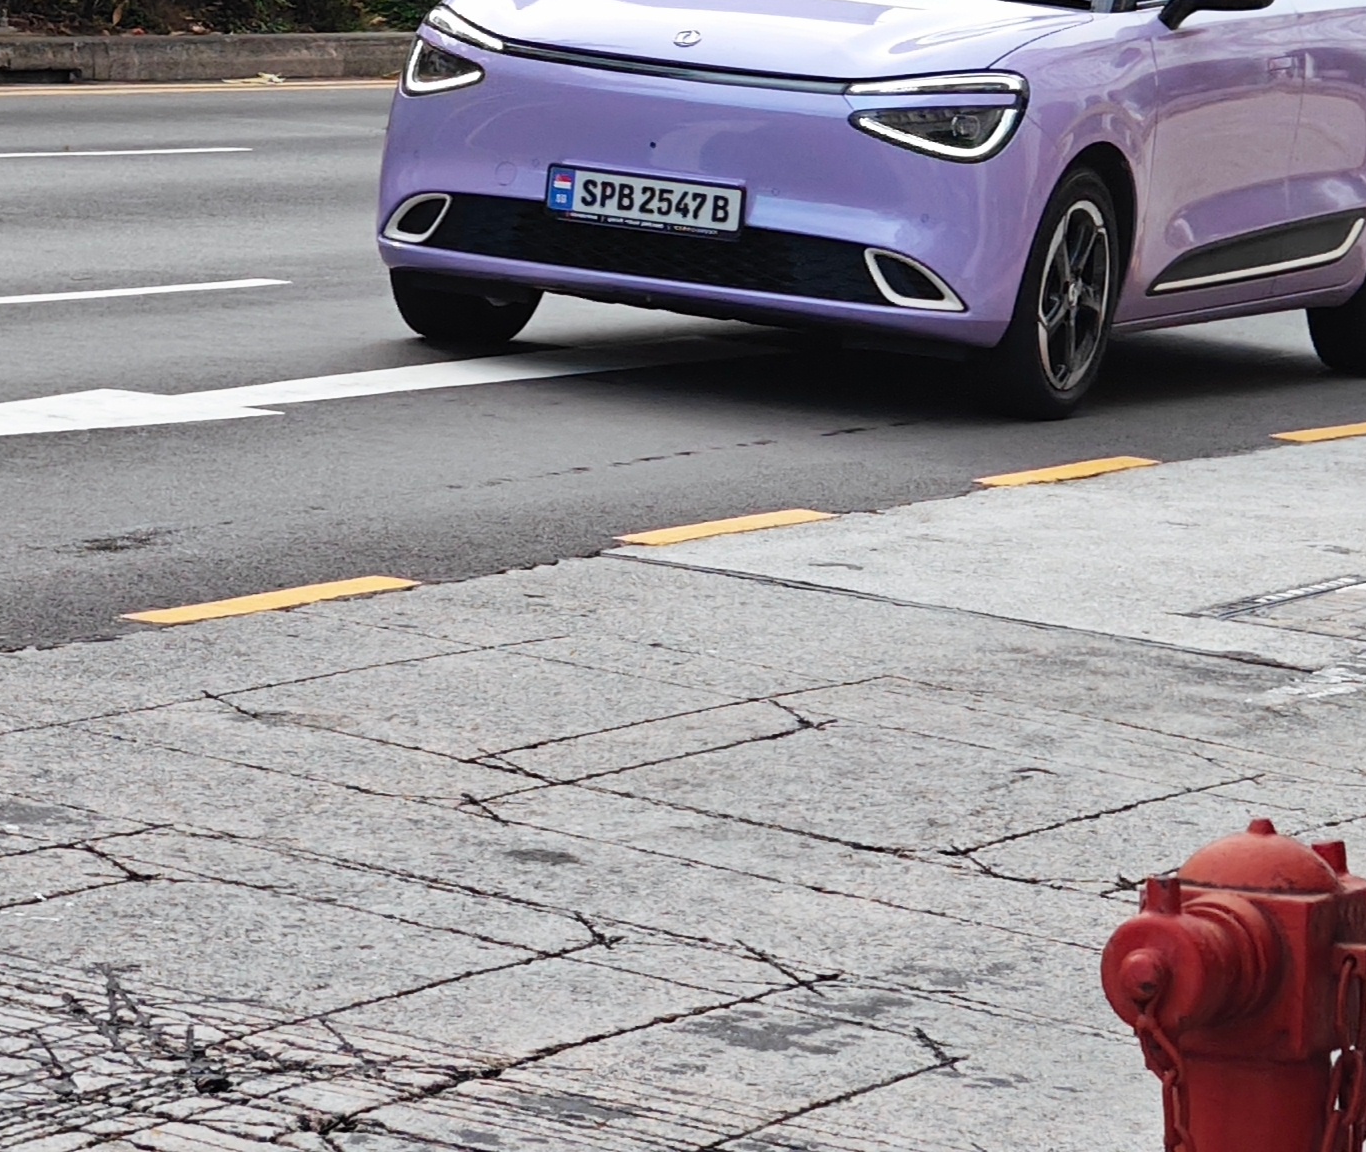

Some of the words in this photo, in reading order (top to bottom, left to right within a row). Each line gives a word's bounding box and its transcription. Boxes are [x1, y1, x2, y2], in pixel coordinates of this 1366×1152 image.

[581, 179, 634, 210] SPB
[638, 186, 707, 220] 2547
[711, 194, 730, 223] B
